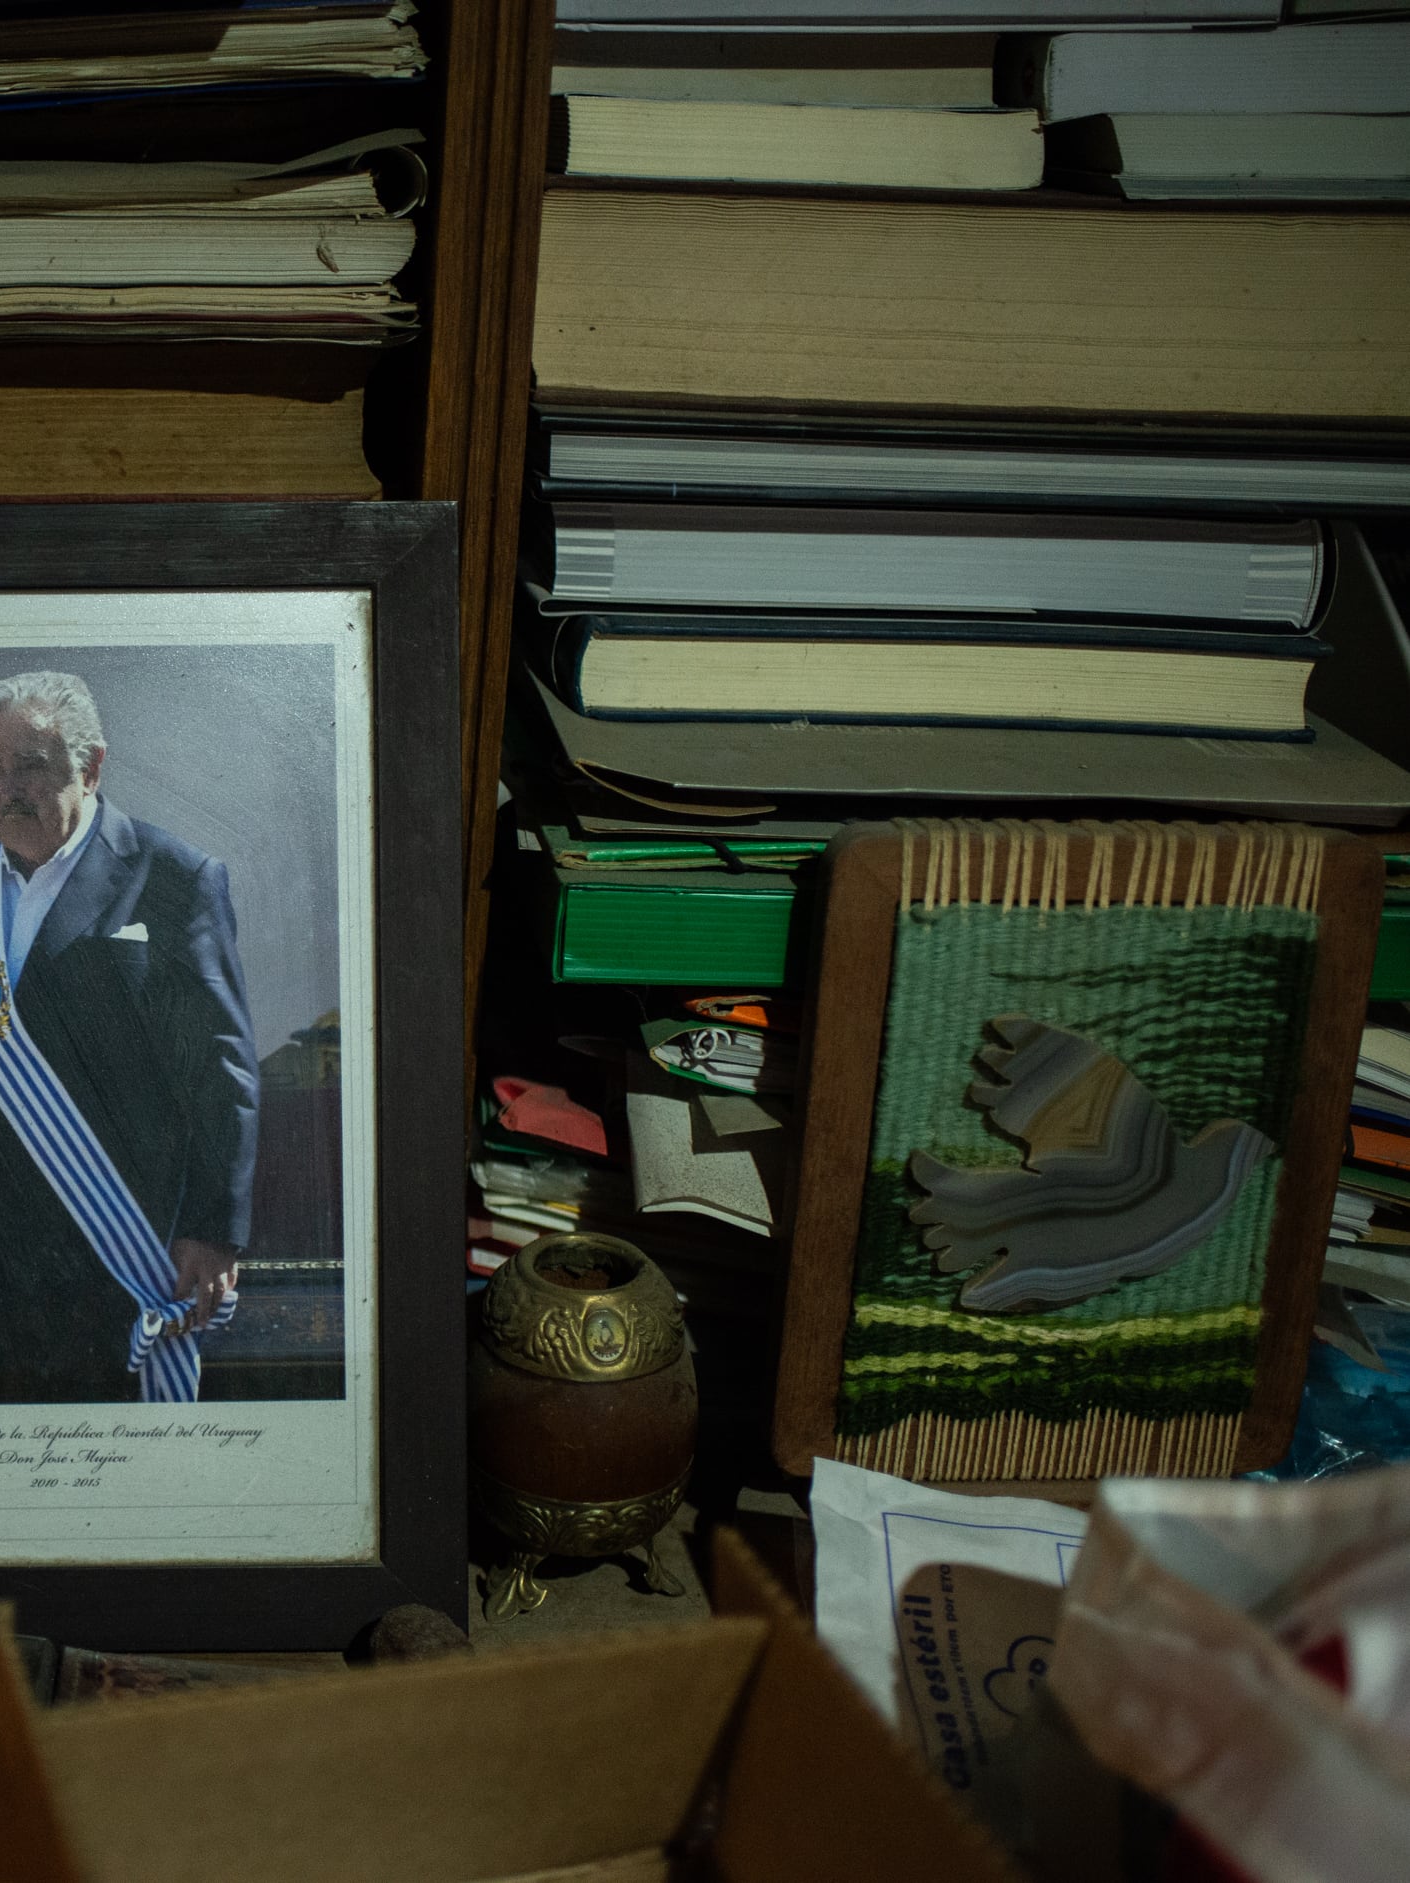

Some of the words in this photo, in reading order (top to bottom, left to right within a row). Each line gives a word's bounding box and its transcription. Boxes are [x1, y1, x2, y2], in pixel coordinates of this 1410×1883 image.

[9, 1425, 23, 1440] la
[28, 1421, 104, 1450] República
[112, 1422, 174, 1439] Oriental
[175, 1423, 197, 1438] del
[199, 1423, 264, 1448] Uruguay
[30, 1450, 68, 1472] José
[70, 1449, 133, 1474] Mujica
[30, 1478, 59, 1488] 2010
[72, 1477, 101, 1488] 2015
[941, 1564, 954, 1593] ETO
[945, 1597, 958, 1622] por
[903, 1594, 950, 1702] estéril
